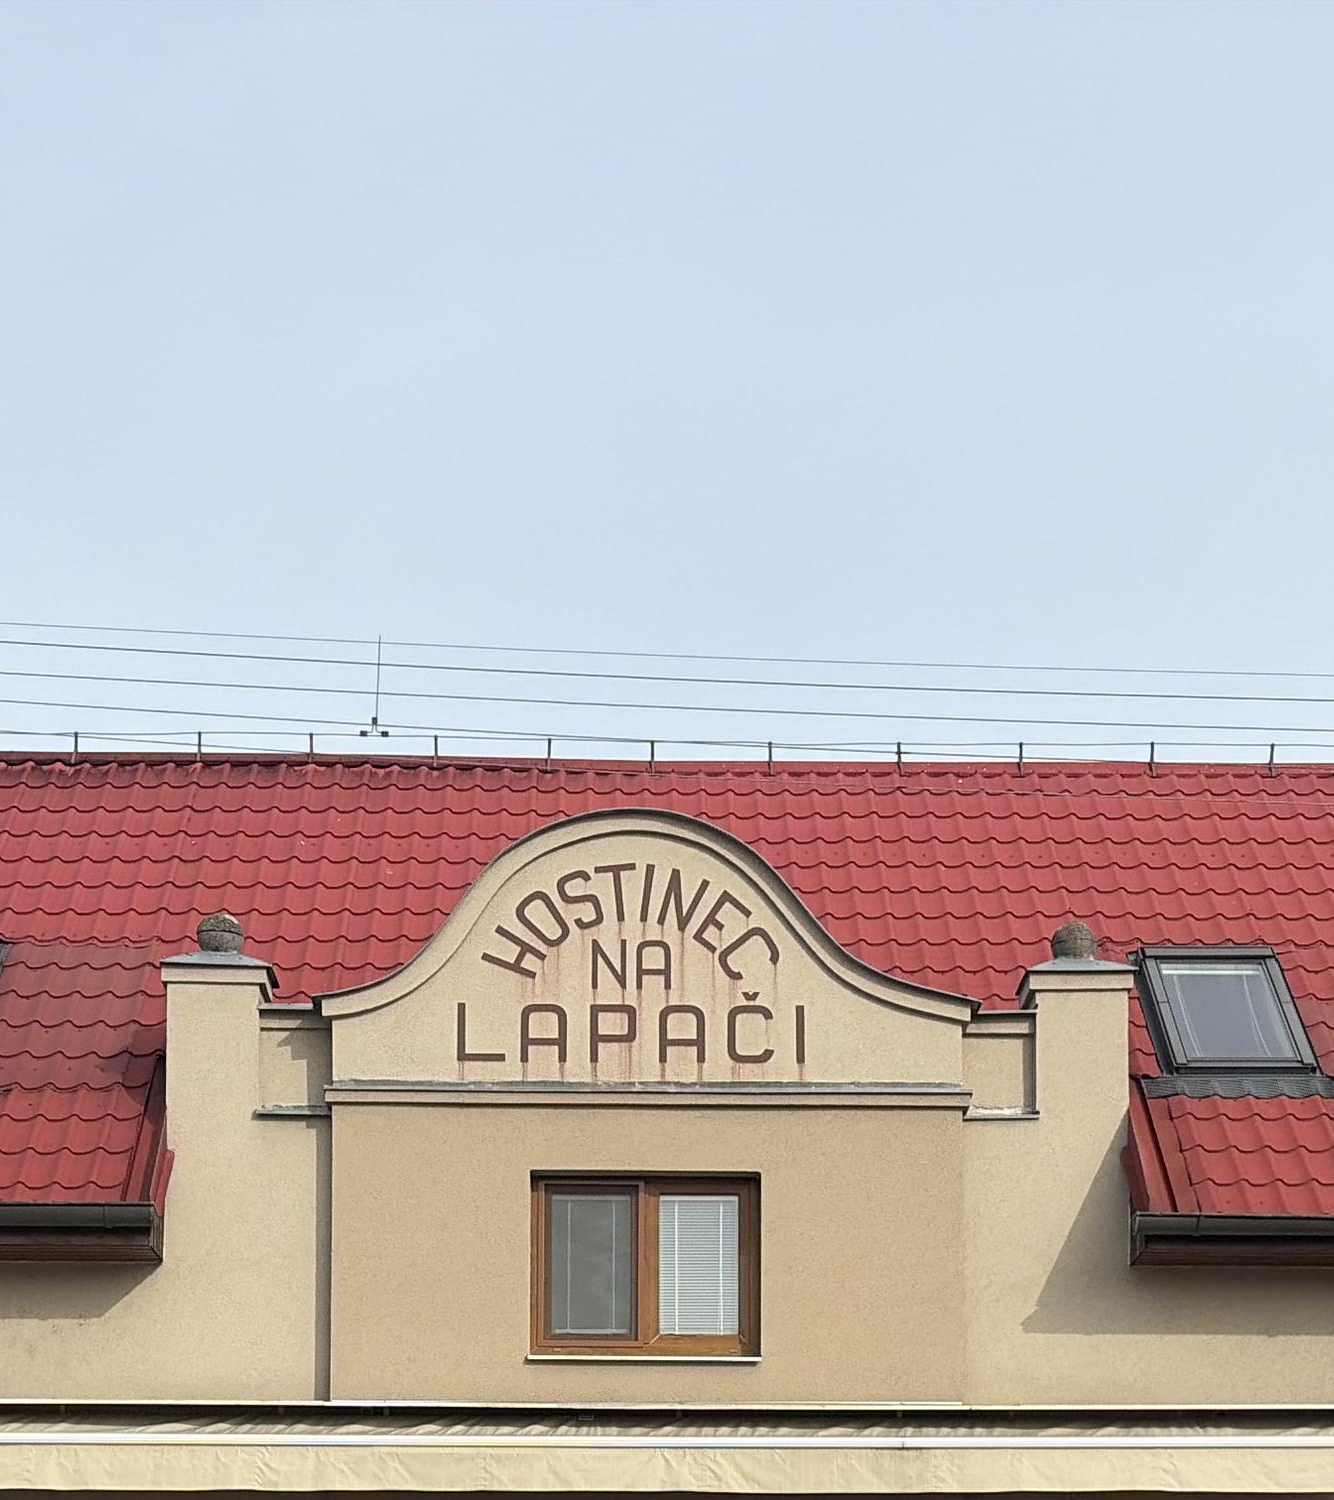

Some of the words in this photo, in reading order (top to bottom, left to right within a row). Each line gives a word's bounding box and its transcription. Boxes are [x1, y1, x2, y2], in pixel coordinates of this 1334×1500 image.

[481, 862, 780, 981] HOSTINEC
[591, 938, 672, 990] NA
[456, 990, 806, 1065] LAPAČI
